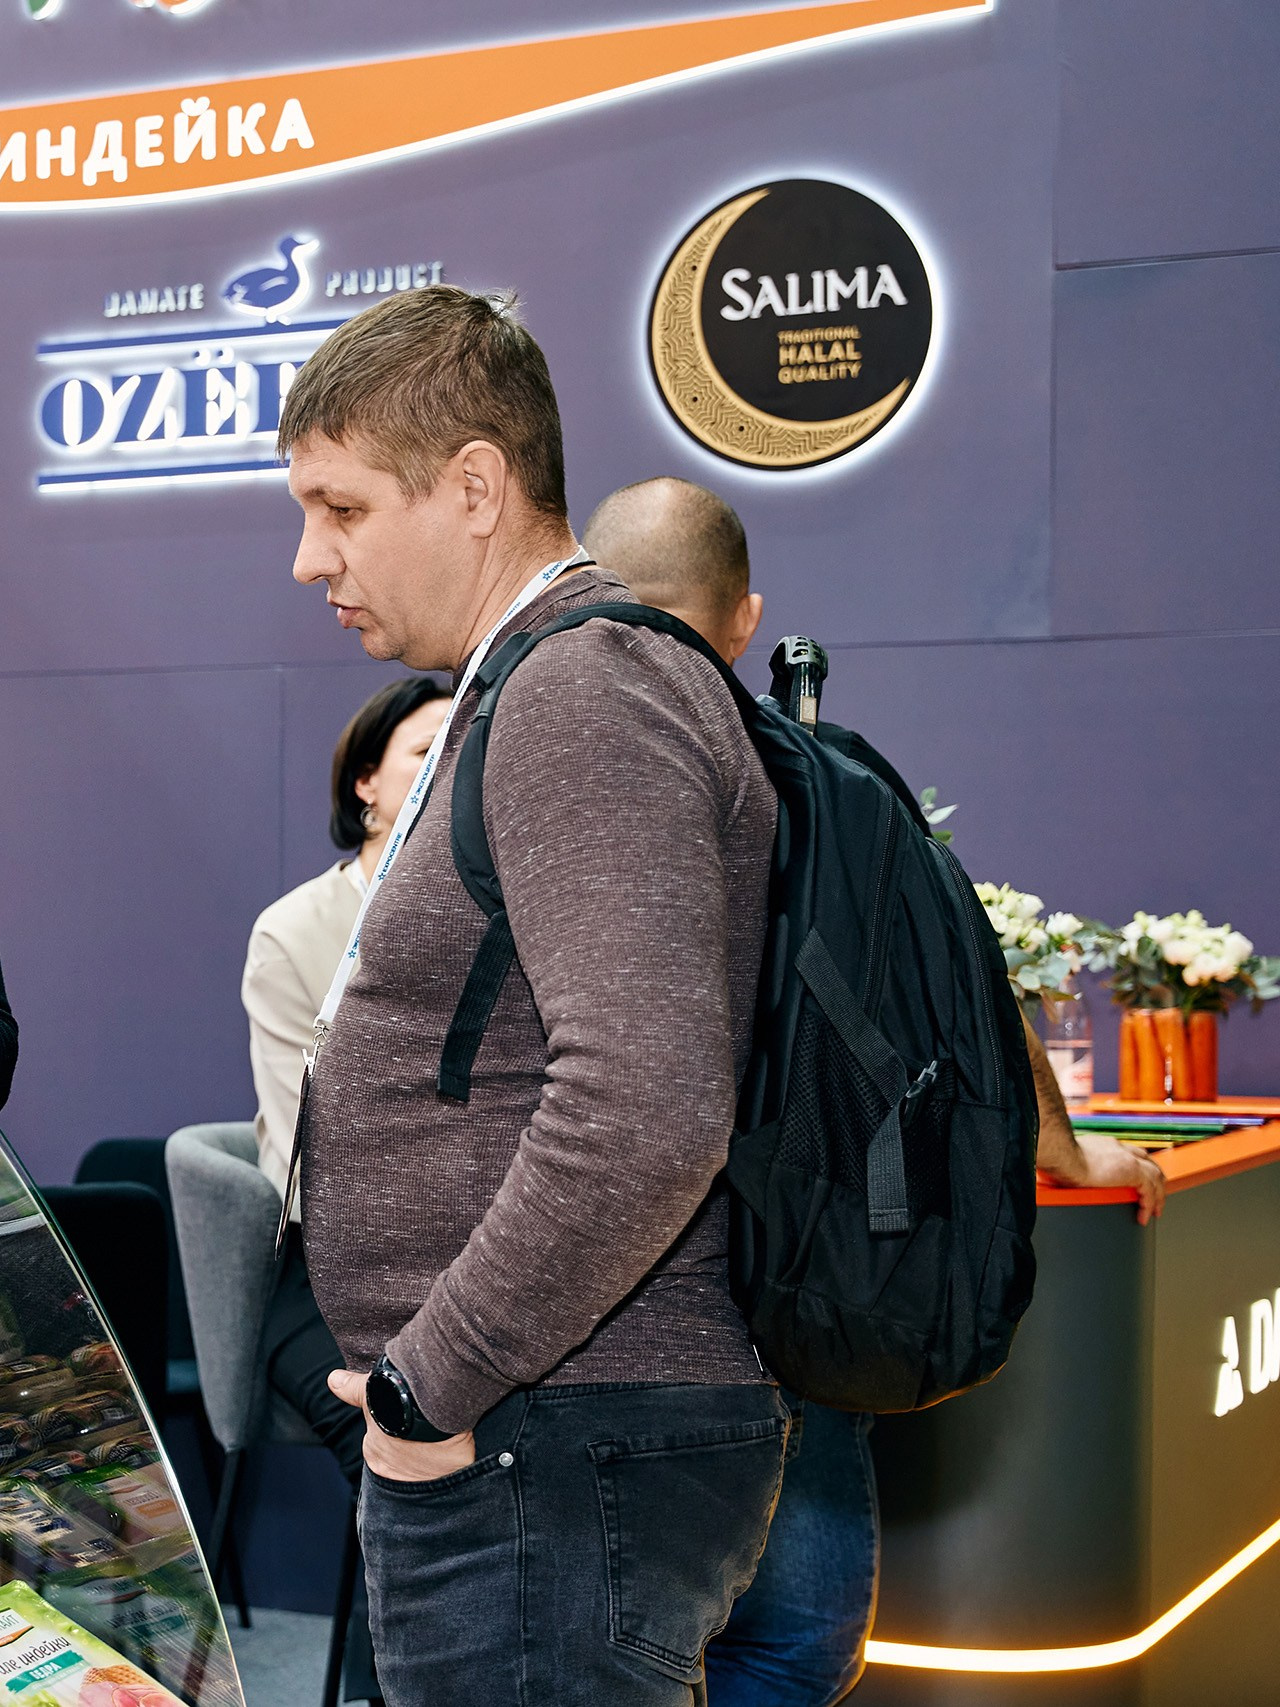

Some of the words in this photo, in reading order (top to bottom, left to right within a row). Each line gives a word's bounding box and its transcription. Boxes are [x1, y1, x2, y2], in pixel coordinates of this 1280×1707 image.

[720, 264, 909, 321] SALIMA
[777, 325, 863, 345] TRADITIONAL
[778, 339, 863, 366] HALAL
[777, 361, 863, 385] QUALITY
[382, 832, 403, 874] EXPOCENTRE
[20, 1635, 72, 1666] индейки
[30, 1662, 62, 1680] БЕДРА
